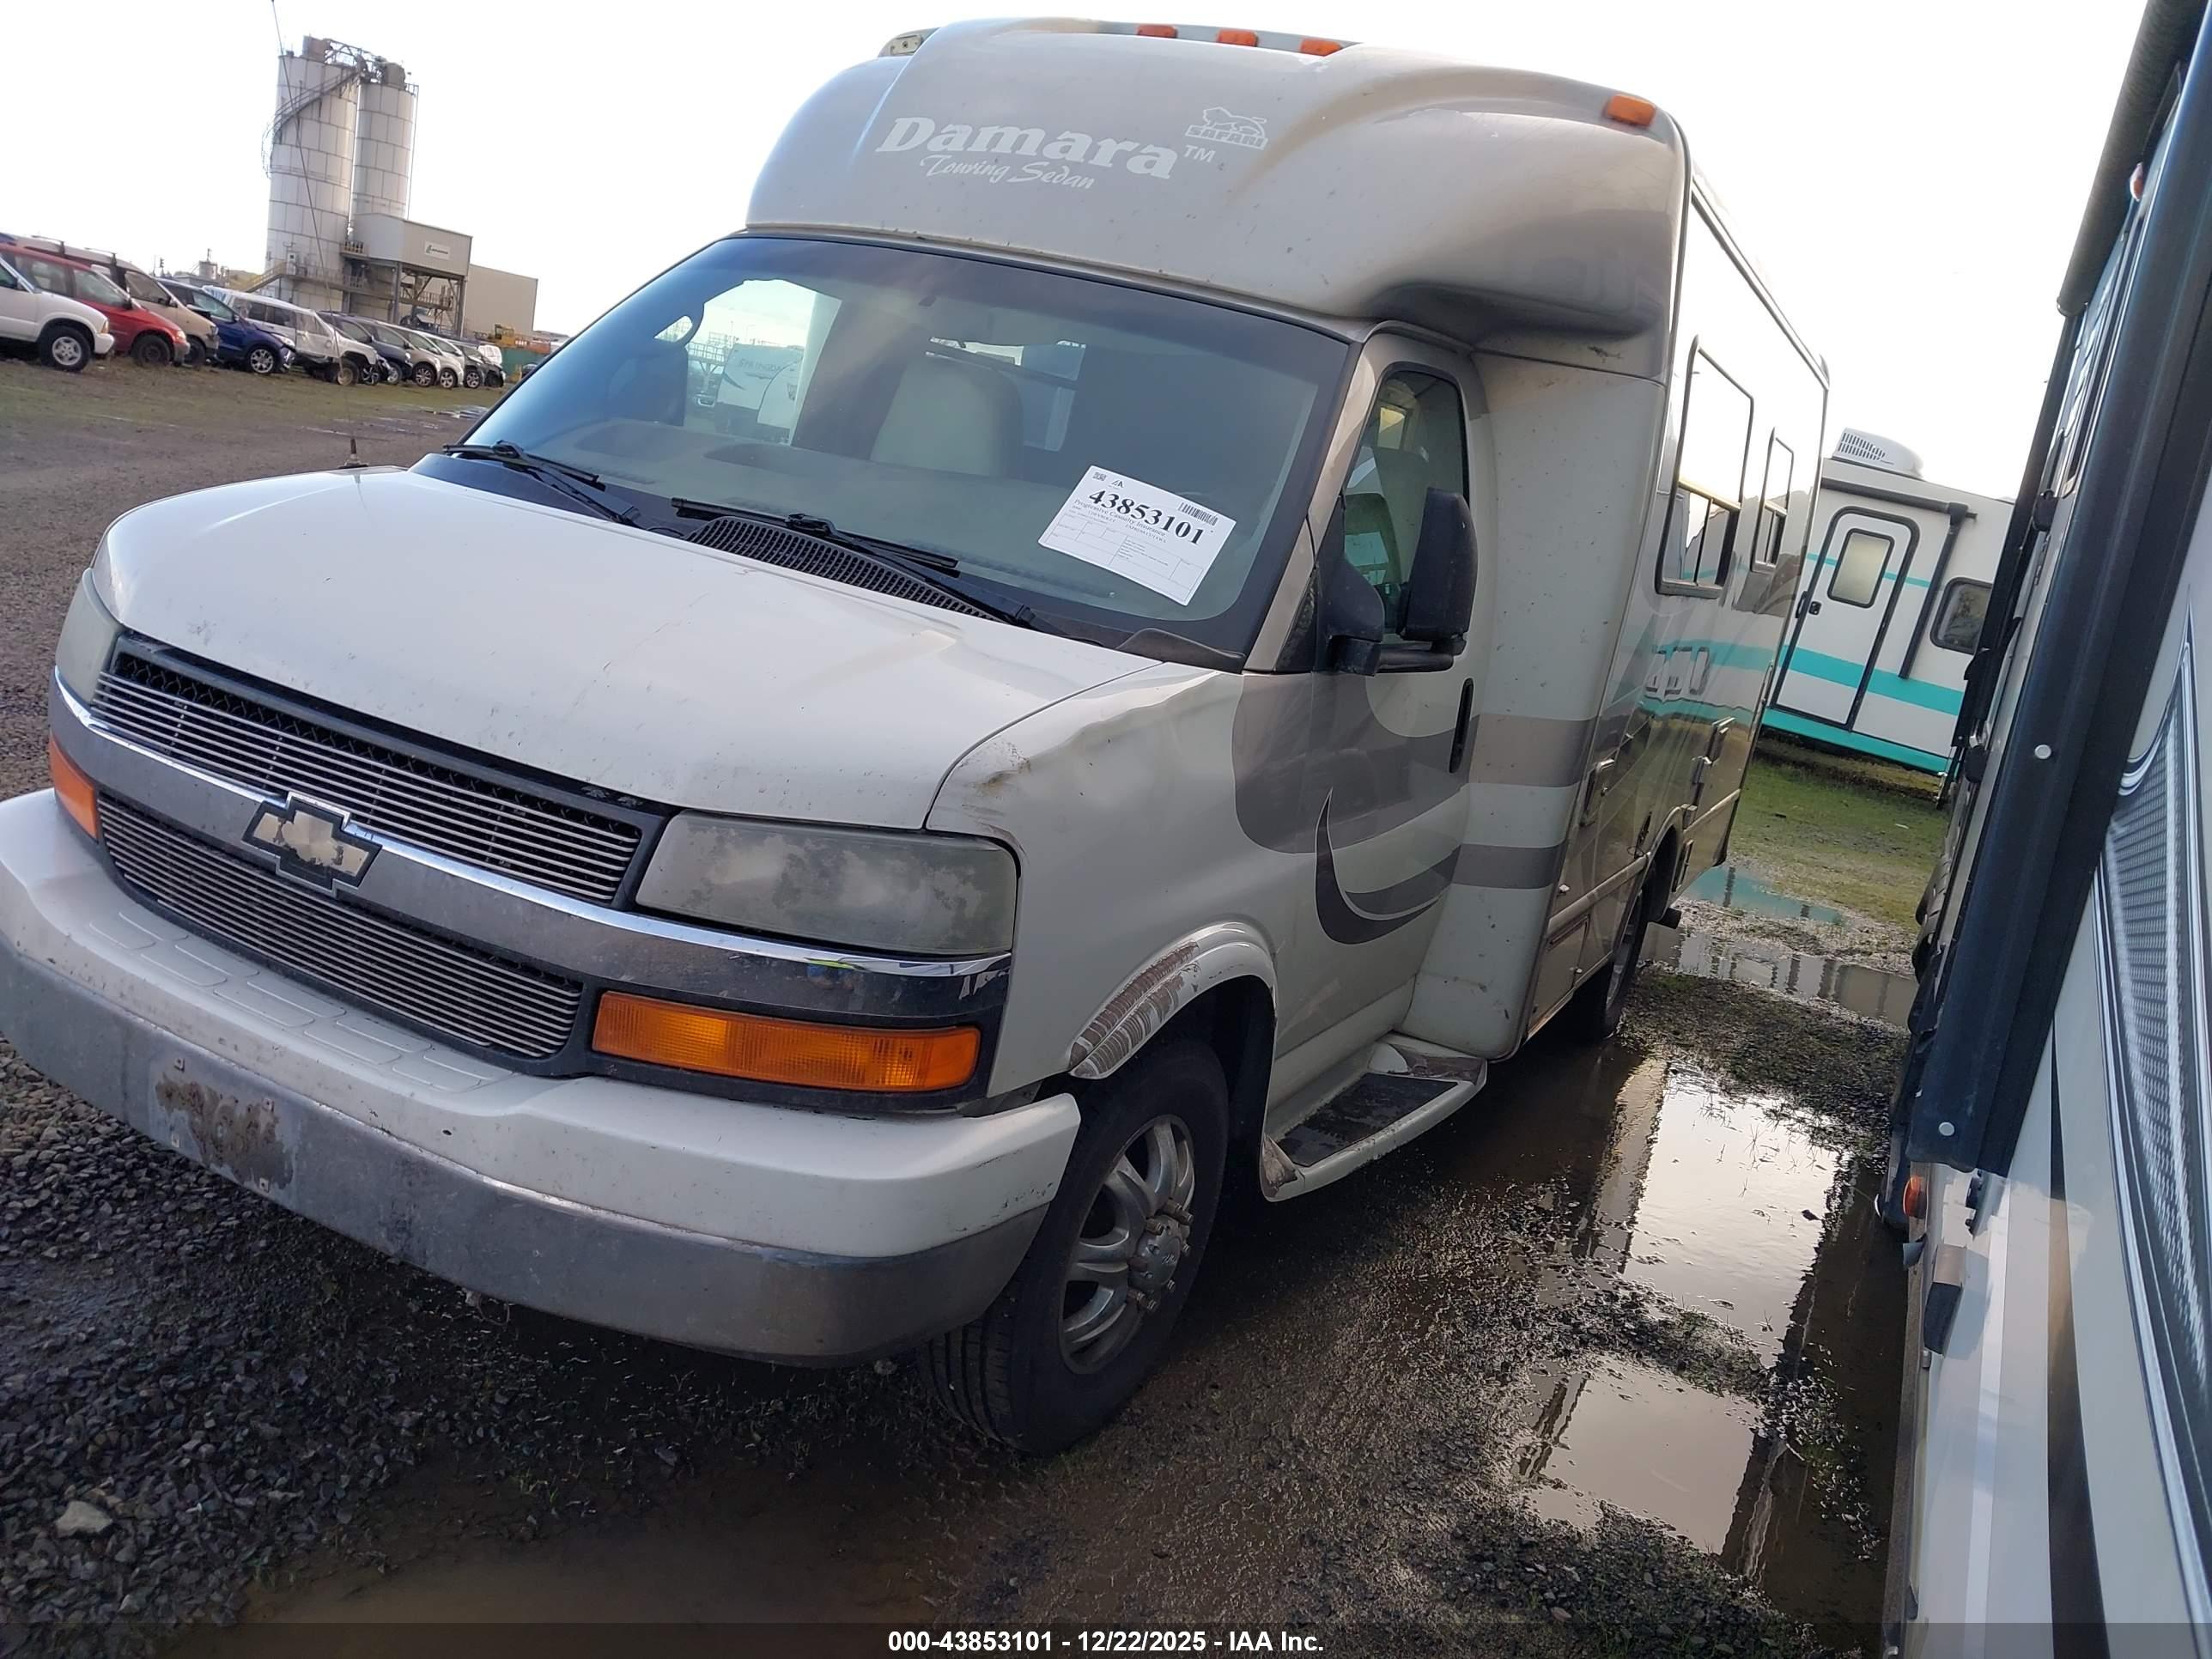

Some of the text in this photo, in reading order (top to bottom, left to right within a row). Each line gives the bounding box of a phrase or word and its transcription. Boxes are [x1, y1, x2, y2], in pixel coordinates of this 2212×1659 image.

[875, 116, 1216, 179] Damara TM
[1185, 125, 1268, 150] SAFARI
[920, 155, 1096, 189] Touring Sedan
[1088, 489, 1204, 545] 43853101
